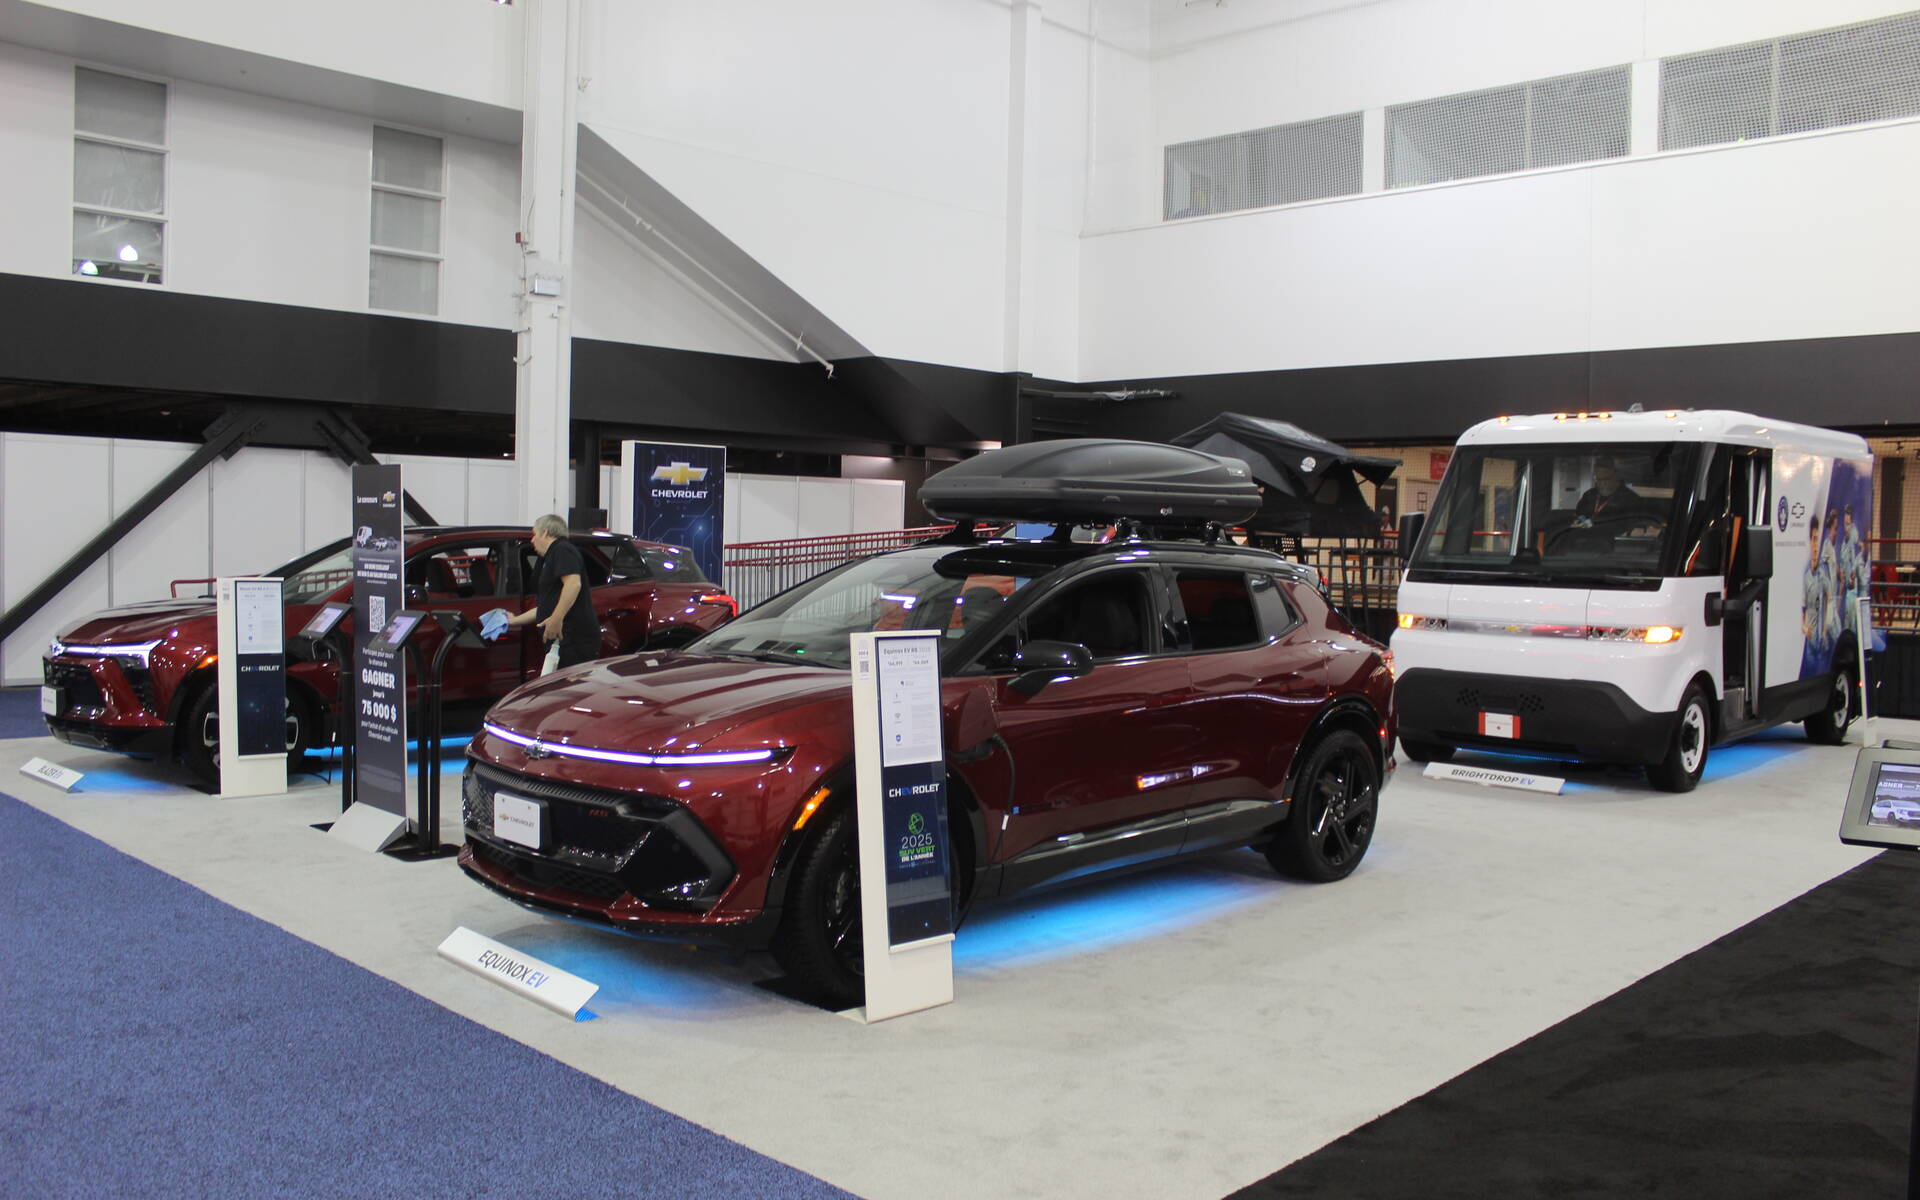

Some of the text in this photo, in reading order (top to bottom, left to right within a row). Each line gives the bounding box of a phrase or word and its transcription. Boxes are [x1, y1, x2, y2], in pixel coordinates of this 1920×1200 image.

[651, 489, 708, 499] CHEVROLET
[362, 668, 395, 689] GAGNER
[361, 699, 397, 723] 75 000 $
[1451, 769, 1535, 785] BRIGHTDROP EV
[889, 783, 940, 798] CHEVROLET
[901, 833, 933, 849] 2025
[899, 844, 936, 857] SUV VERT
[477, 950, 549, 988] EQUINOX EV
